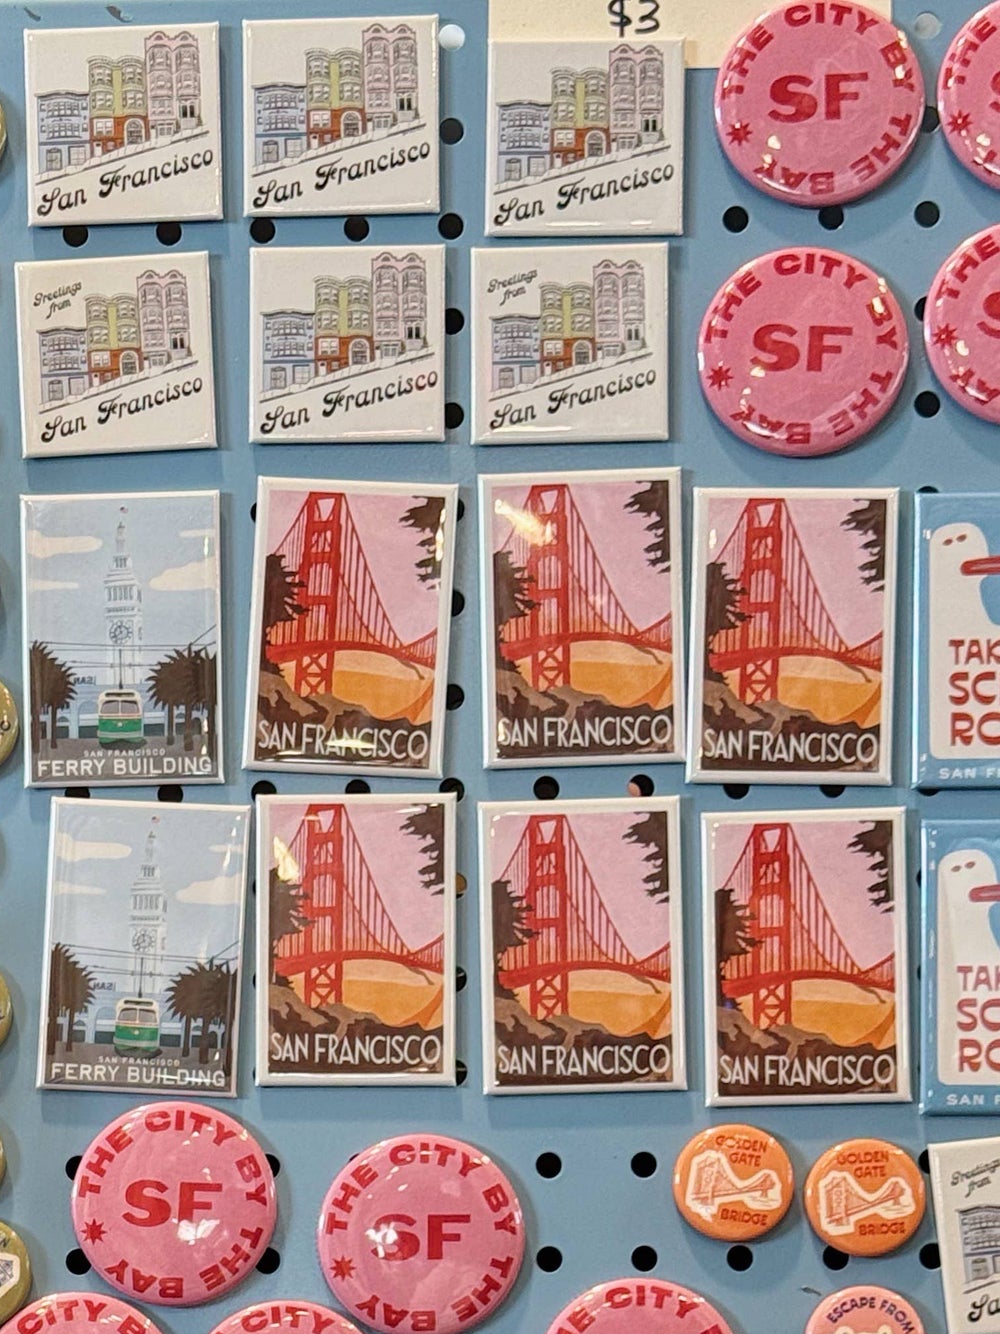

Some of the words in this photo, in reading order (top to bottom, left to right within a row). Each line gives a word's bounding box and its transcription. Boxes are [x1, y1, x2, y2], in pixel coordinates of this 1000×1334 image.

[768, 71, 869, 125] SF
[37, 184, 87, 216] San
[99, 148, 214, 198] Francisco
[493, 199, 545, 226] San
[557, 162, 675, 210] Francisco
[32, 280, 82, 307] Greetings
[487, 268, 538, 295] Greetings
[750, 324, 854, 373] SF
[40, 416, 87, 443] San
[98, 376, 203, 424] Francisco
[489, 403, 537, 429] San
[548, 369, 657, 415] Francisco
[501, 718, 534, 746] SAN
[544, 714, 672, 747] FRANCISCO
[704, 728, 742, 759] SAN
[749, 731, 877, 763] FRANCISCO
[37, 757, 104, 777] FERRY
[113, 756, 212, 775] BUILDING
[271, 1032, 307, 1062] SAN
[313, 1032, 441, 1065] FRANCISCO
[51, 1062, 120, 1082] FERRY
[127, 1066, 225, 1087] BUILDING
[720, 1054, 758, 1085] SAN
[764, 1054, 895, 1086] FRANCISCO
[144, 1110, 238, 1147] CITY
[79, 1126, 134, 1199] THE
[836, 1150, 889, 1164] GOLDEN
[854, 1166, 886, 1178] GATE
[234, 1153, 268, 1207] BY
[122, 1179, 224, 1227] SF
[371, 1213, 472, 1262] SF
[859, 1222, 905, 1236] BRIDGE
[198, 1226, 264, 1292] THE
[104, 1259, 185, 1299] BAY
[826, 1296, 876, 1324] ESCAPE
[879, 1299, 914, 1334] FROM
